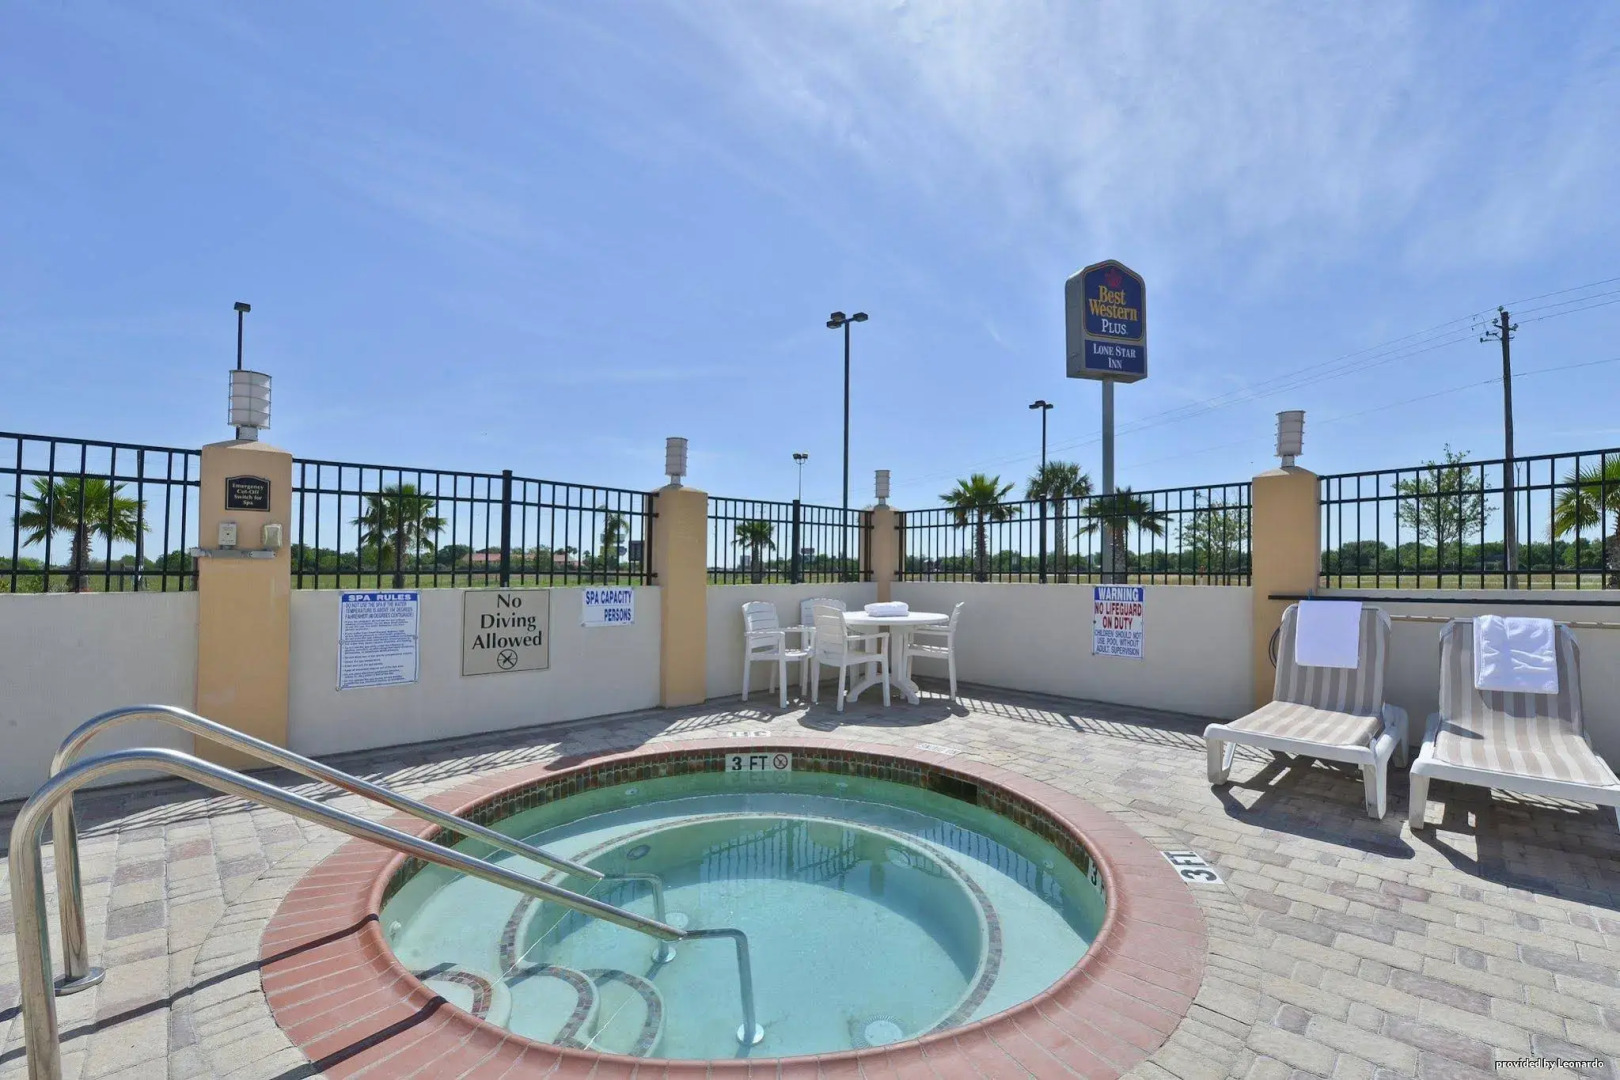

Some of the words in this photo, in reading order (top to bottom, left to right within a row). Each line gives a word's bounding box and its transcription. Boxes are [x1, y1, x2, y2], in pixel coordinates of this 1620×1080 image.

[1099, 285, 1127, 304] Best
[1089, 299, 1138, 321] Western
[1102, 319, 1127, 334] PLUS
[1093, 343, 1114, 355] LONE
[1116, 346, 1136, 358] STAR
[1109, 357, 1122, 369] INN
[497, 594, 522, 608] No
[586, 591, 598, 605] SPA
[601, 591, 632, 604] CAPACITY
[1099, 588, 1139, 600] WARNING
[604, 608, 631, 621] PERSONS
[1095, 602, 1103, 614] NO
[1106, 602, 1141, 616] LIFEGUARD
[481, 613, 536, 632] Diving
[1103, 616, 1112, 628] ON
[1114, 617, 1132, 630] DUTY
[472, 631, 542, 650] Allowed
[1096, 645, 1109, 653] ADULT
[1111, 646, 1139, 655] SUPERVISION
[732, 757, 742, 770] 3
[750, 756, 768, 770] FT
[1181, 870, 1217, 880] 3
